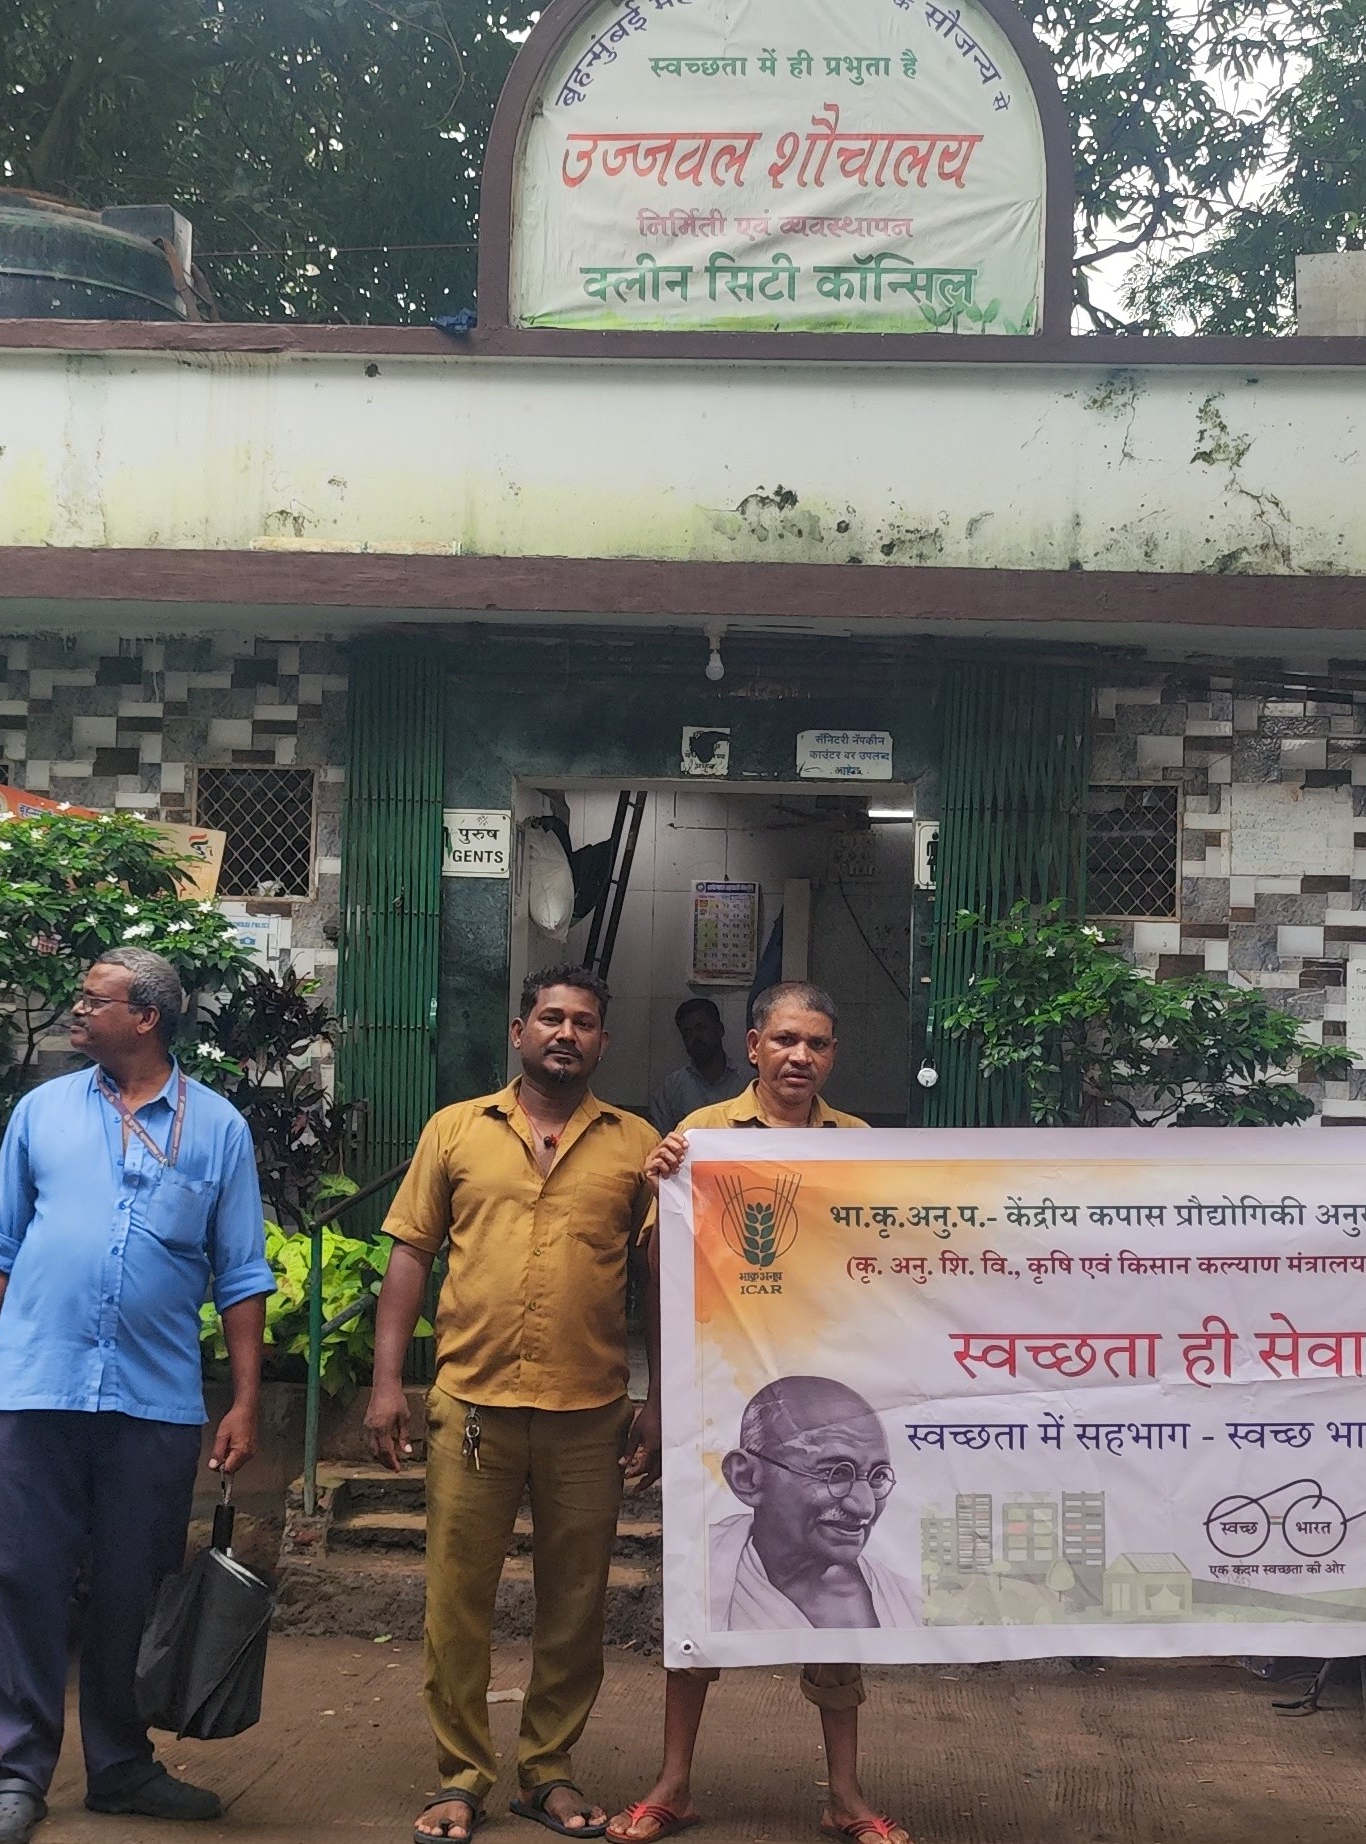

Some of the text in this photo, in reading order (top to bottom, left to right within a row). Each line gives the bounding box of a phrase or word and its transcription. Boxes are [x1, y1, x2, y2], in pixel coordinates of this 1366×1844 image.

[648, 48, 918, 86] स्वच्छता में ही प्रभुता है
[925, 2, 1002, 84] सौजन्य
[993, 91, 1010, 111] से
[561, 101, 985, 190] उज्जवल शौचालय
[636, 209, 914, 241] निर्मिती एवं व्यवस्थापन
[579, 252, 979, 305] क्लीन सिटी कॉन्सिल
[844, 751, 856, 760] वर
[458, 828, 500, 844] पुरुष
[452, 849, 504, 863] GENTS
[1004, 1196, 1080, 1230] केंद्रीय
[1086, 1205, 1167, 1228] कपास
[1173, 1194, 1307, 1228] प्रौद्योगिकी
[847, 1256, 883, 1285] (कृ.
[890, 1256, 932, 1285] अनु.
[939, 1250, 974, 1276] शि.
[980, 1250, 1020, 1280] वि.,
[1027, 1250, 1075, 1285] कृषि
[1079, 1252, 1112, 1279] एवं
[1117, 1249, 1191, 1275] किसान
[1196, 1256, 1281, 1275] कल्याण
[740, 1284, 783, 1295] ICAR
[948, 1333, 1163, 1380] स्वच्छता
[1178, 1315, 1239, 1388] ही
[905, 1423, 1028, 1451] स्वच्छता
[1037, 1411, 1065, 1450] में
[1073, 1422, 1191, 1457] सहभाग
[1225, 1422, 1315, 1450] स्वच्छ
[1220, 1521, 1332, 1536] स्वच्छ भारत
[1209, 1560, 1346, 1578] एक कदम स्वच्छता की ओर
